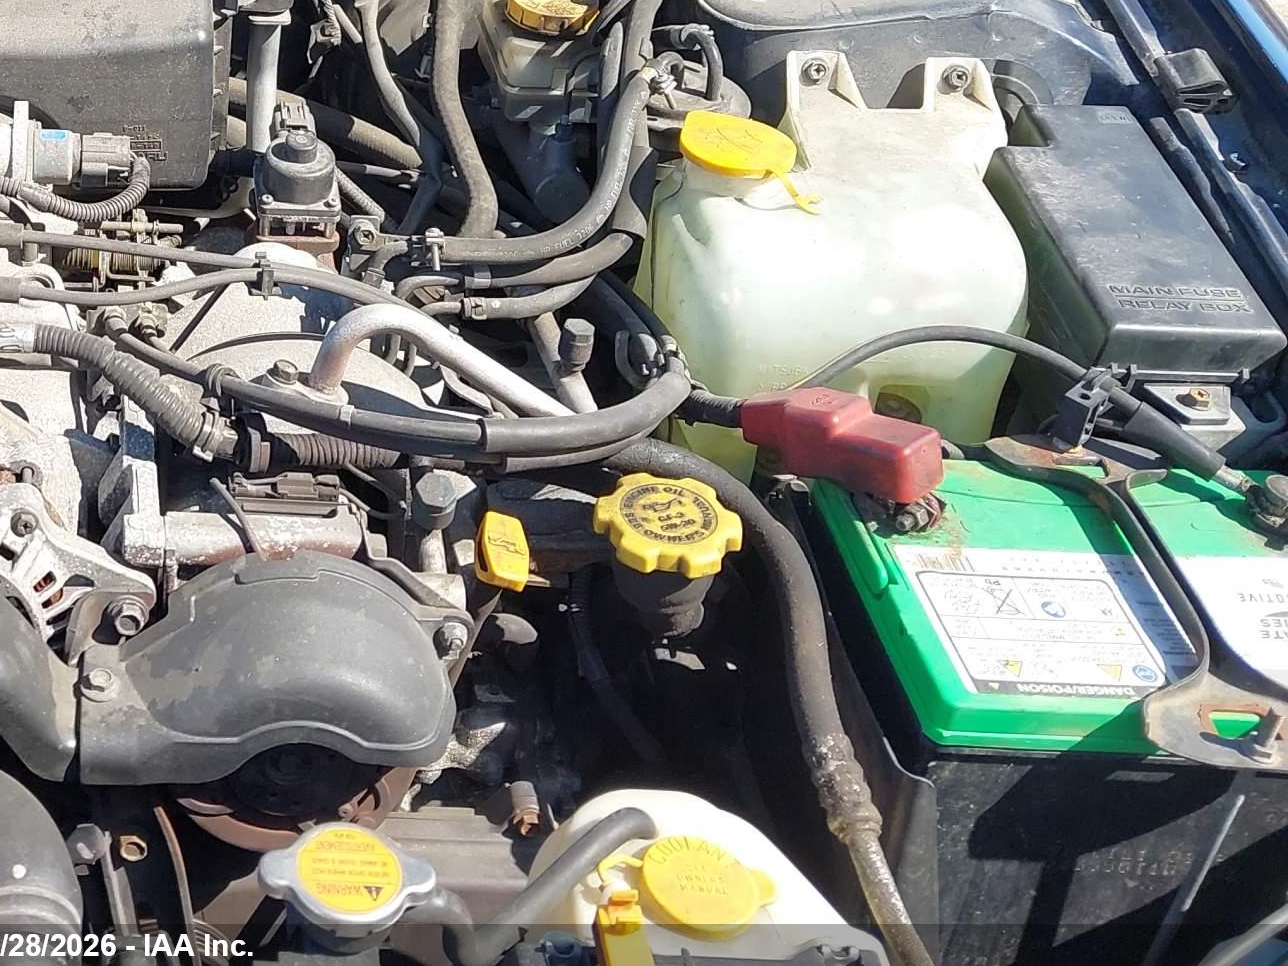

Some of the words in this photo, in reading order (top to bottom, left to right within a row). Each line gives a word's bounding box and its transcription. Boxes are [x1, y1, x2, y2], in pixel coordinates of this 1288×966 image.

[1108, 284, 1176, 296] MAIN
[1177, 287, 1243, 299] FUSE
[1118, 298, 1193, 312] RELAY
[1199, 303, 1254, 314] BOX
[623, 486, 661, 509] ENGINE
[663, 486, 687, 497] OIL
[691, 496, 714, 531] MANUAL
[1238, 592, 1288, 603] OTIVE
[1017, 681, 1136, 698] DANGER/POISON
[316, 883, 362, 896] WARNING
